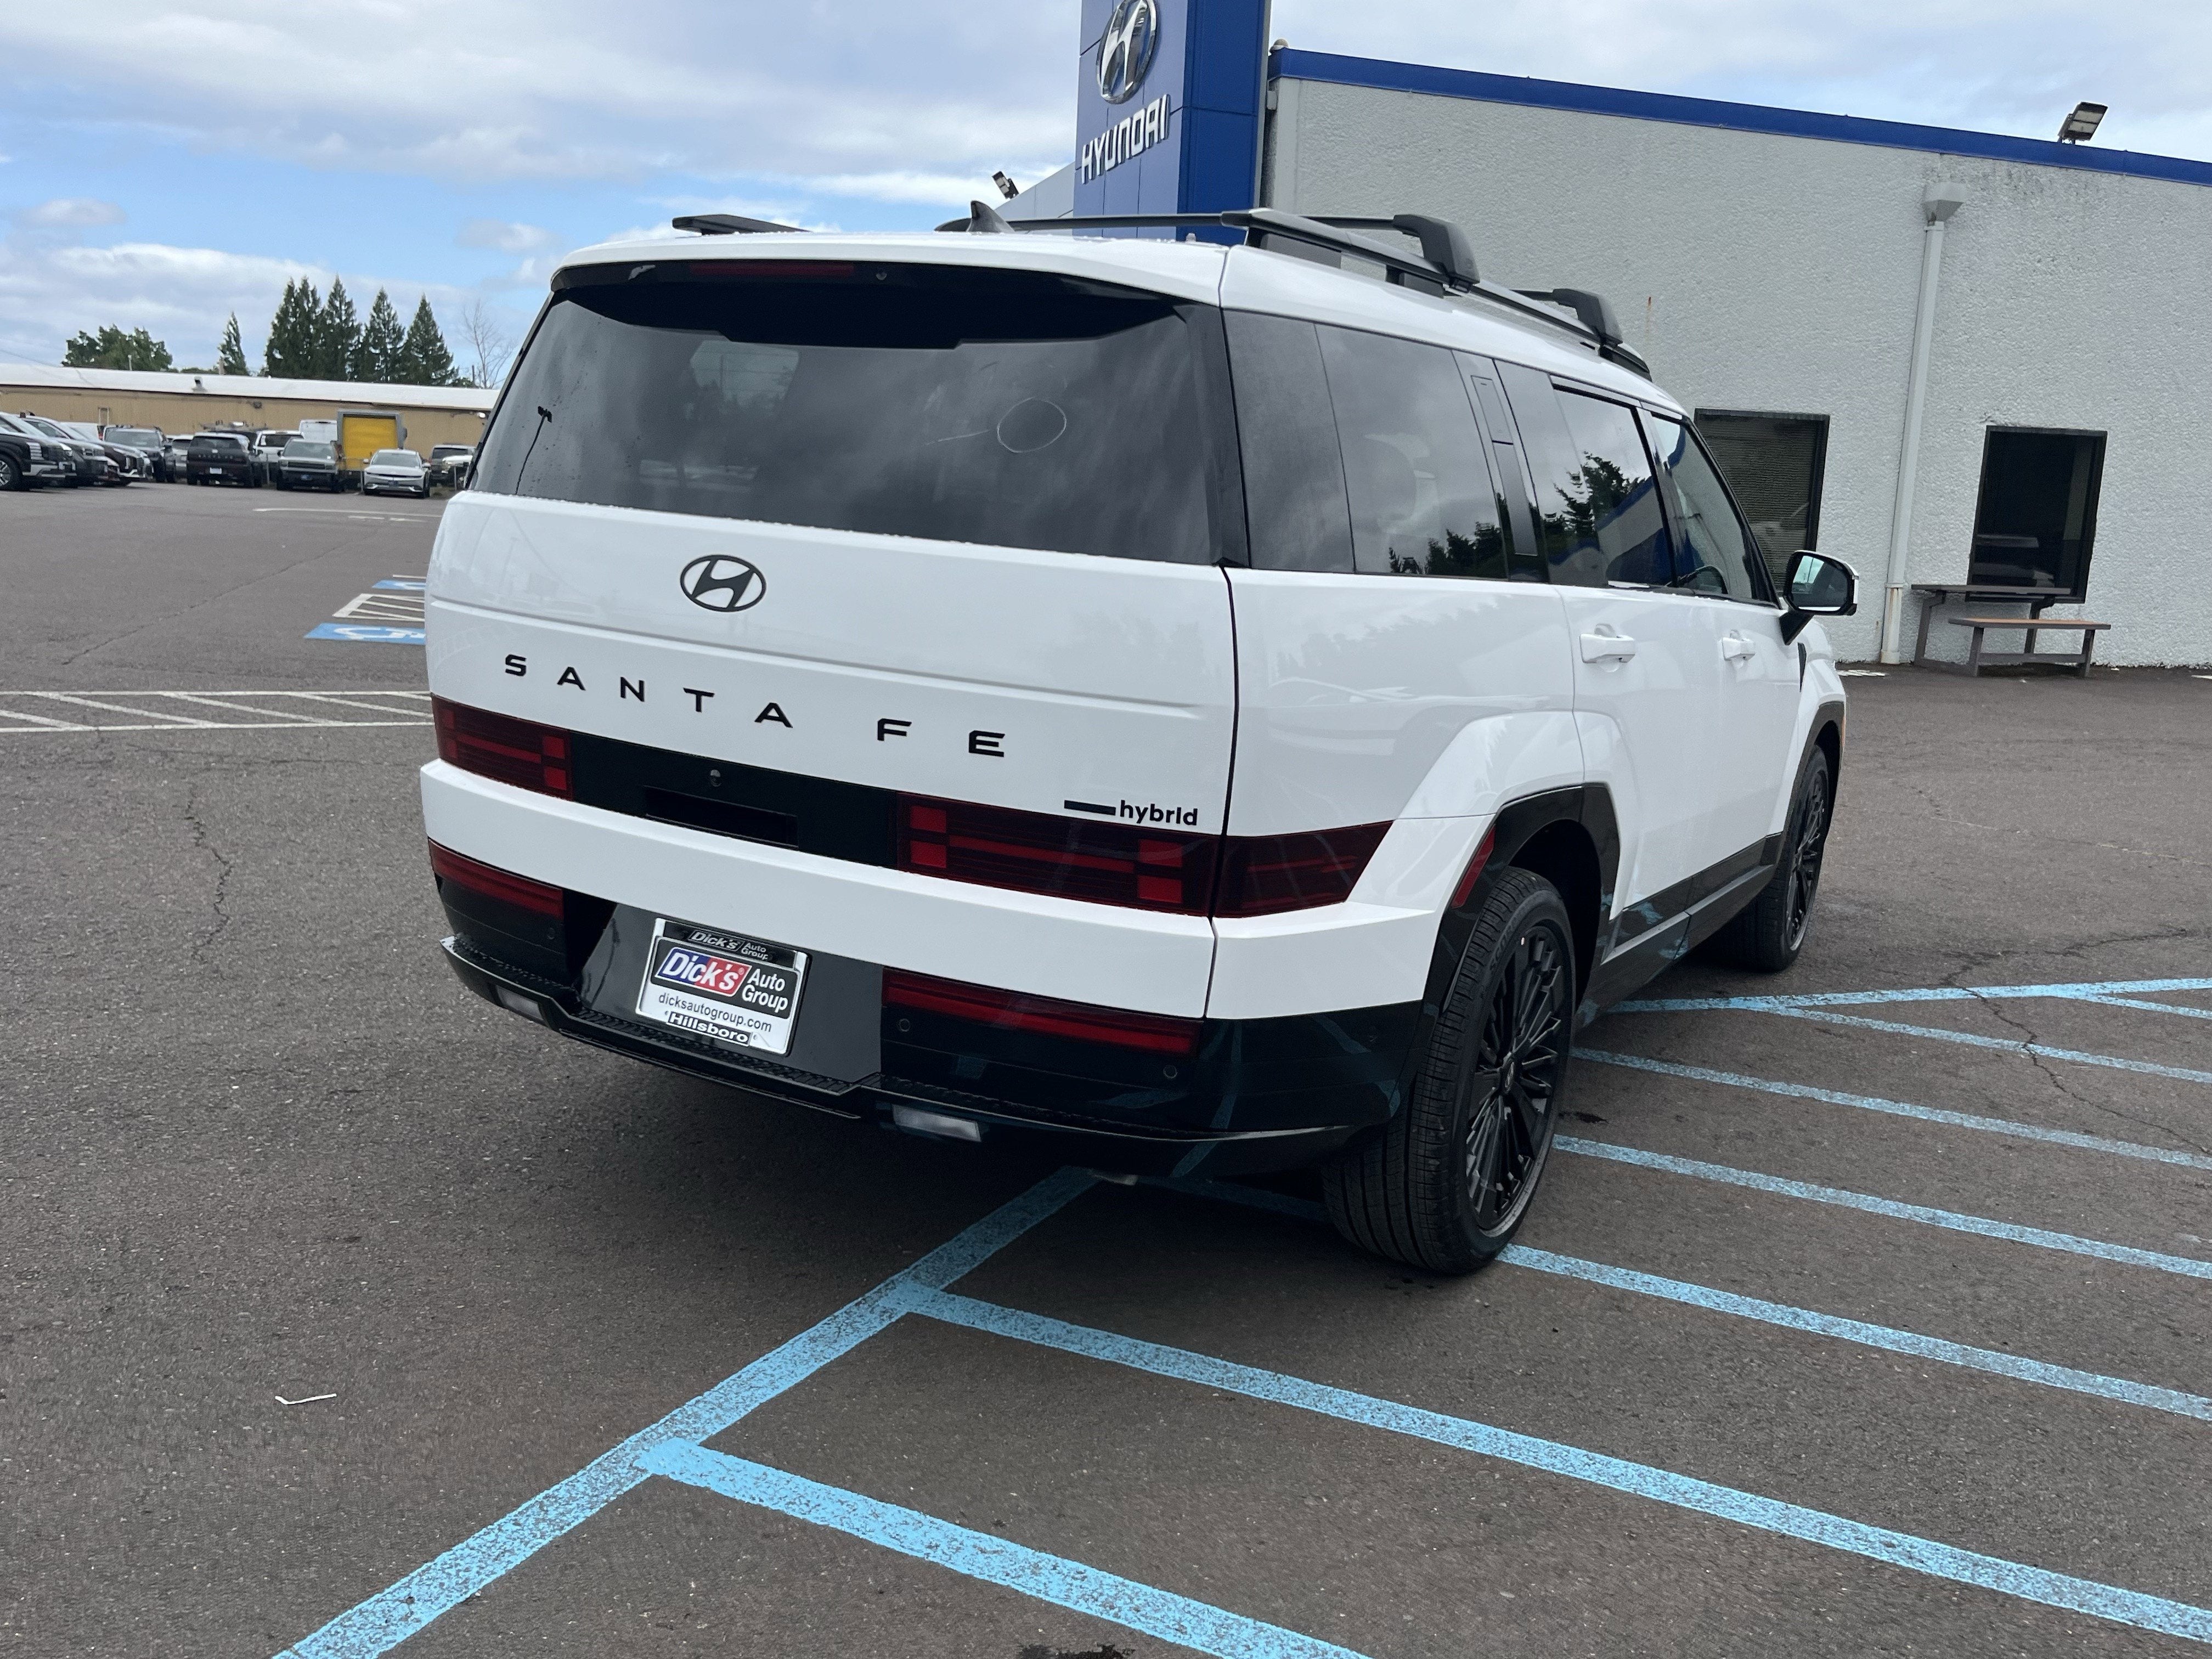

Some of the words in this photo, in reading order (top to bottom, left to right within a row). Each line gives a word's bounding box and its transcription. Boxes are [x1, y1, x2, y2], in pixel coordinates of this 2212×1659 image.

[1081, 94, 1169, 184] HYUNDAI
[504, 653, 793, 729] SANTA
[877, 718, 1006, 758] FE
[1120, 799, 1198, 826] hybrid
[691, 932, 738, 949] Dick's
[741, 947, 769, 961] Group
[746, 942, 766, 952] Auto
[662, 952, 739, 991] Dick's
[747, 968, 785, 991] Auto
[658, 992, 771, 1032] dicksautogroup.com
[742, 984, 788, 1013] Group
[668, 1012, 748, 1043] Hillsboro
